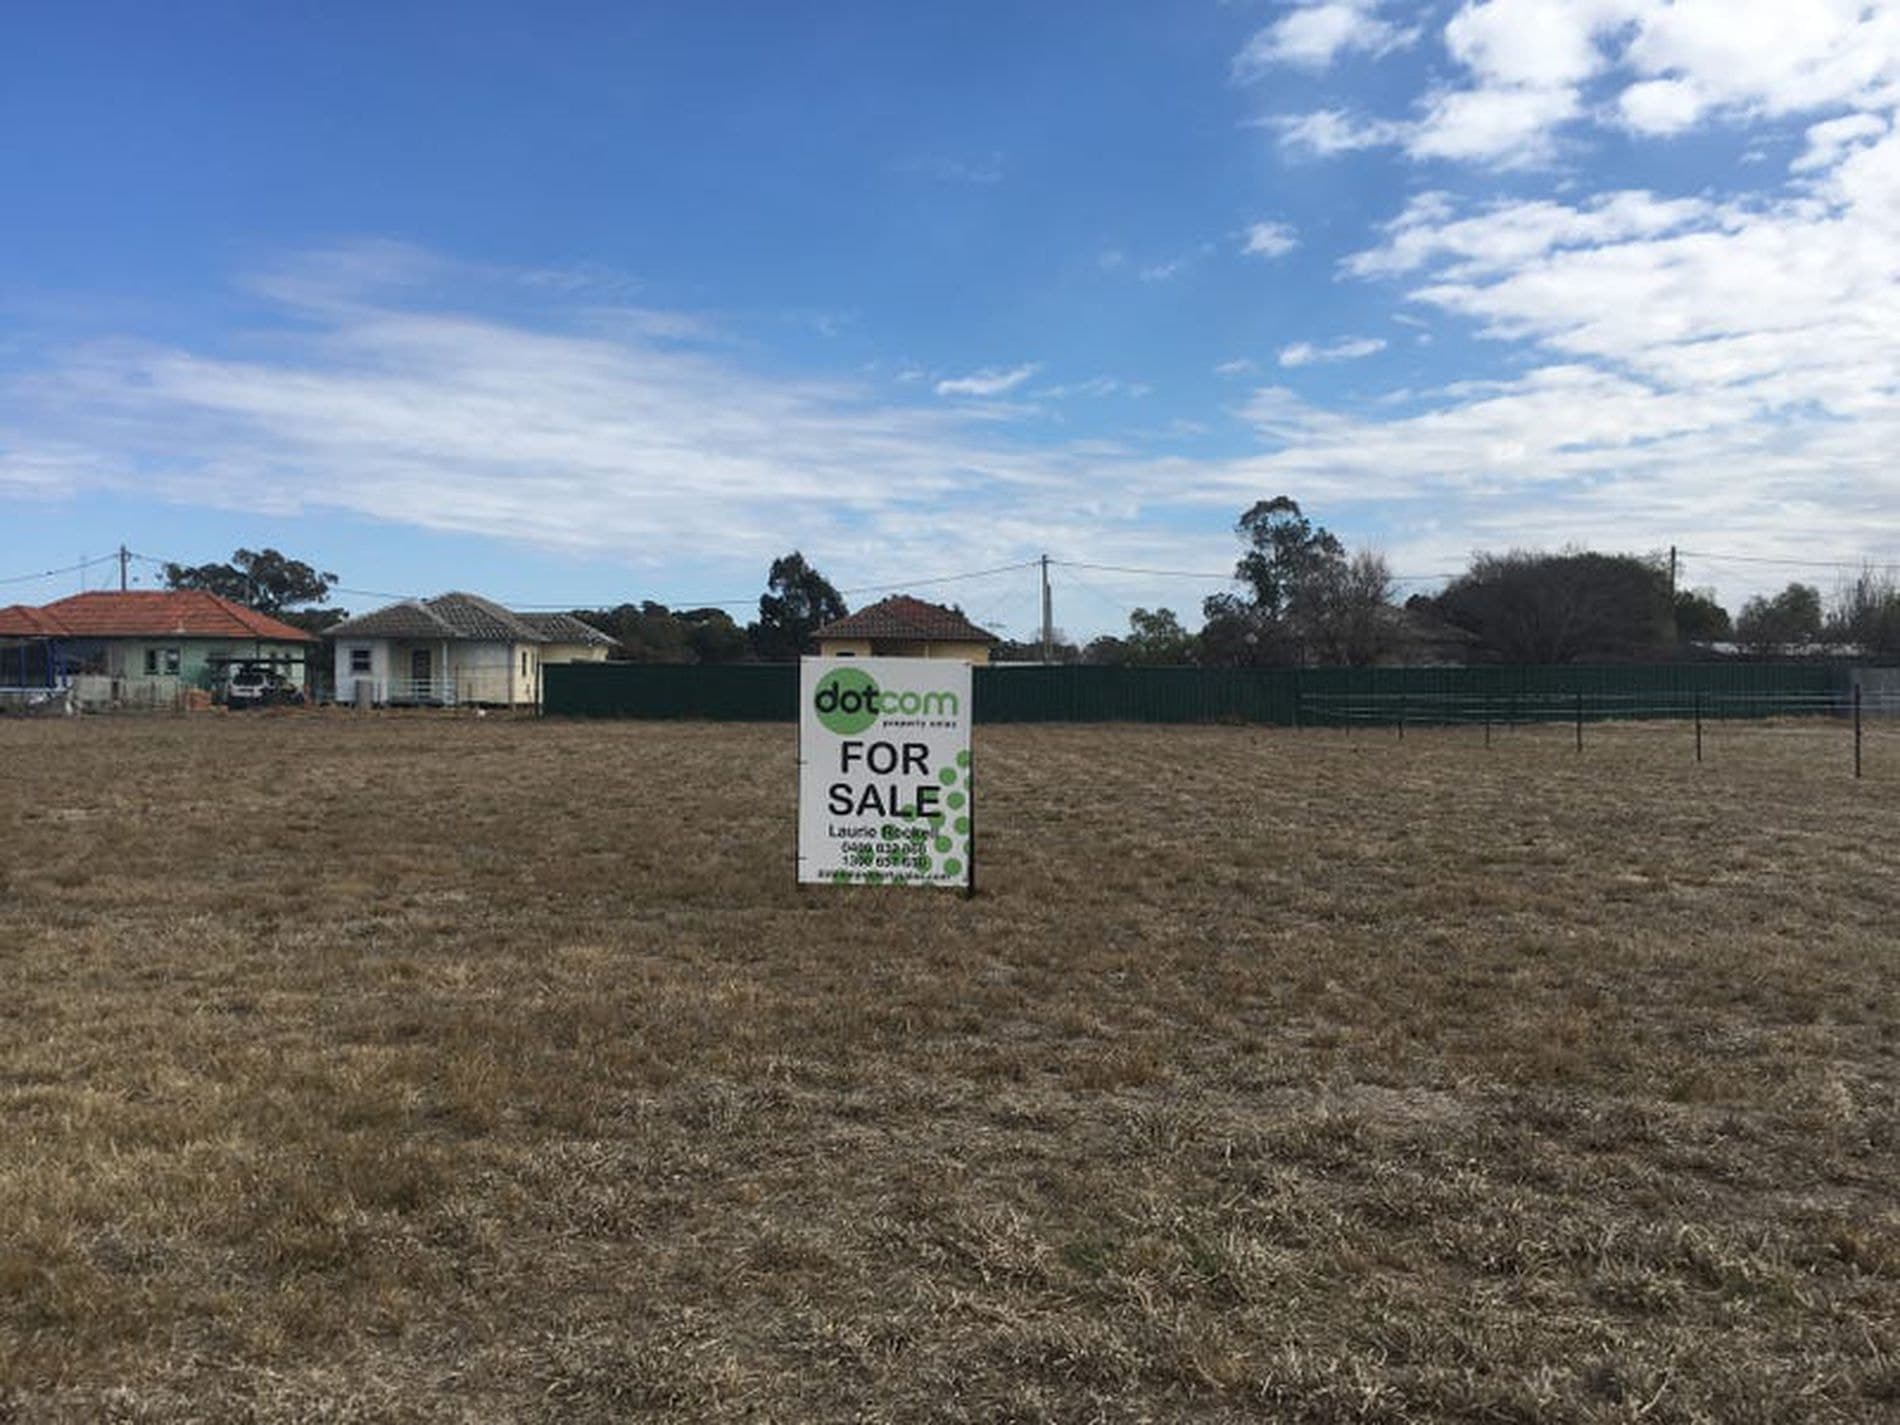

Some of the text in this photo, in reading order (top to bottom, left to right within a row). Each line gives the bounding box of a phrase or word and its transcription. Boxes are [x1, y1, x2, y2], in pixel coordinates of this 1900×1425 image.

[815, 680, 959, 716] dotcom
[841, 741, 930, 776] FOR
[828, 783, 942, 818] SALE
